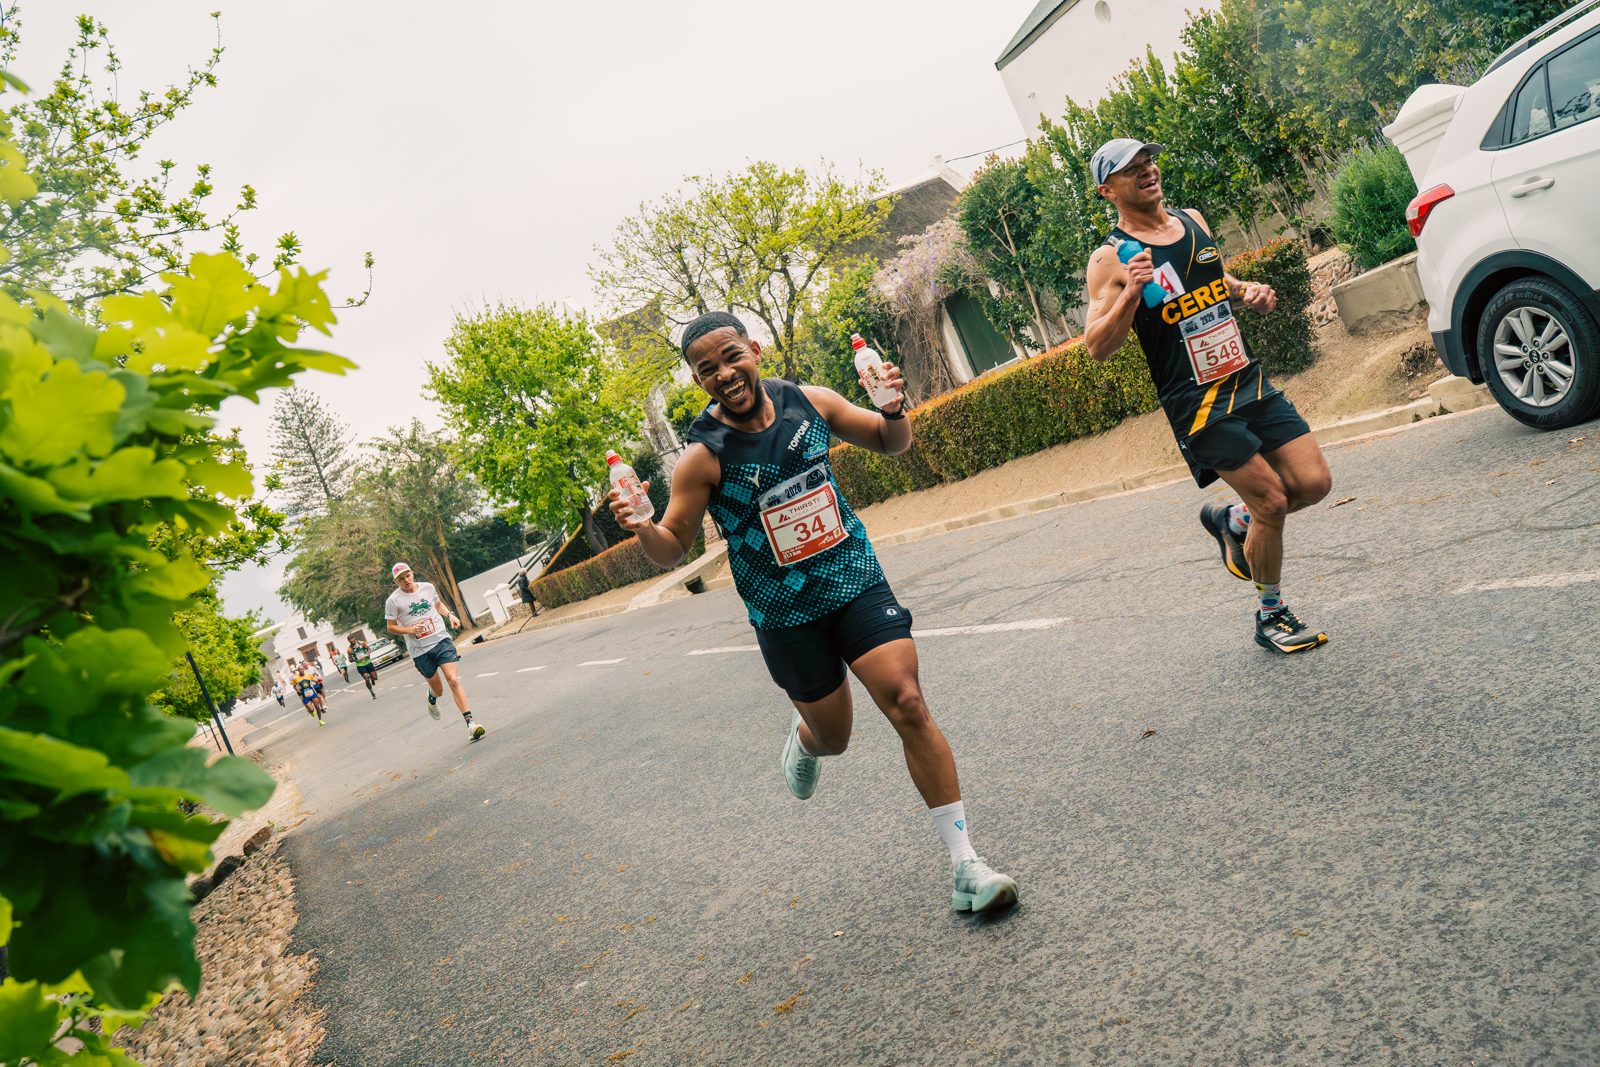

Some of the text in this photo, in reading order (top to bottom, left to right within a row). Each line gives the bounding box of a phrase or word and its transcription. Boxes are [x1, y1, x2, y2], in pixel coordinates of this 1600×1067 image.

[1160, 271, 1175, 294] A
[1206, 340, 1239, 367] 548
[787, 420, 810, 451] TOPFORM
[807, 470, 823, 483] ASA
[784, 482, 802, 499] 2026
[789, 497, 821, 514] THIRSTI
[793, 514, 826, 543] 34
